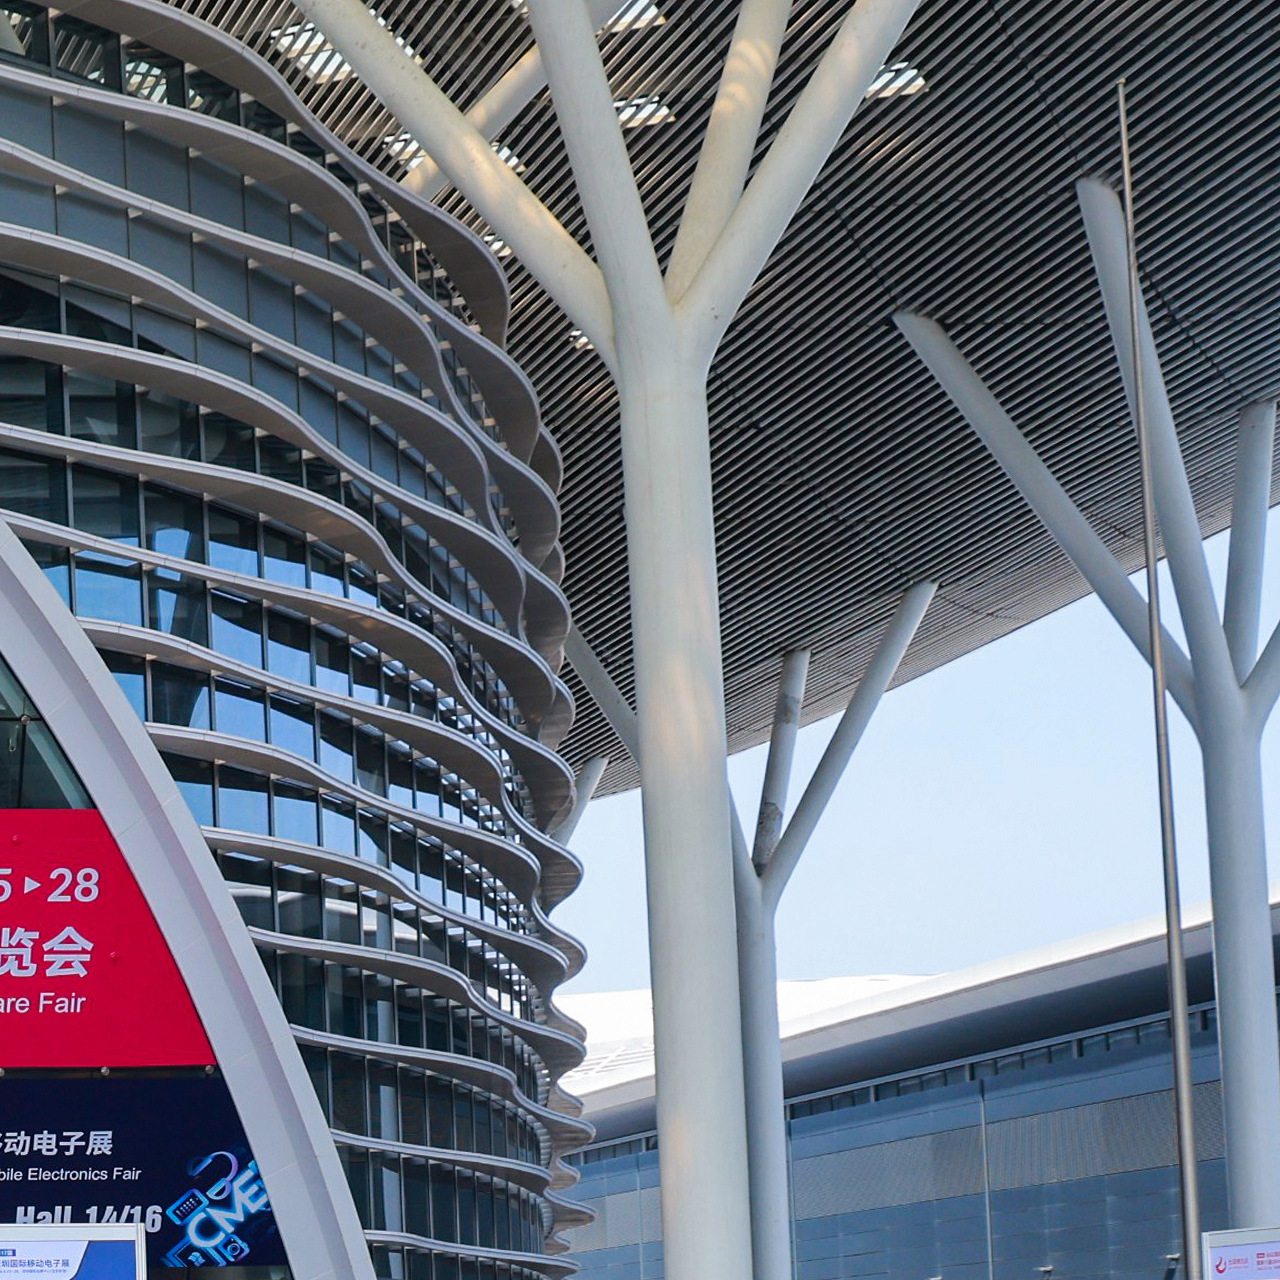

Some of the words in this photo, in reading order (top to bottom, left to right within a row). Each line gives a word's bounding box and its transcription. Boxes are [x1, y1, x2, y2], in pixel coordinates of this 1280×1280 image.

[39, 991, 86, 1014] Fair
[27, 1167, 107, 1181] Electronics
[112, 1167, 142, 1181] Fair
